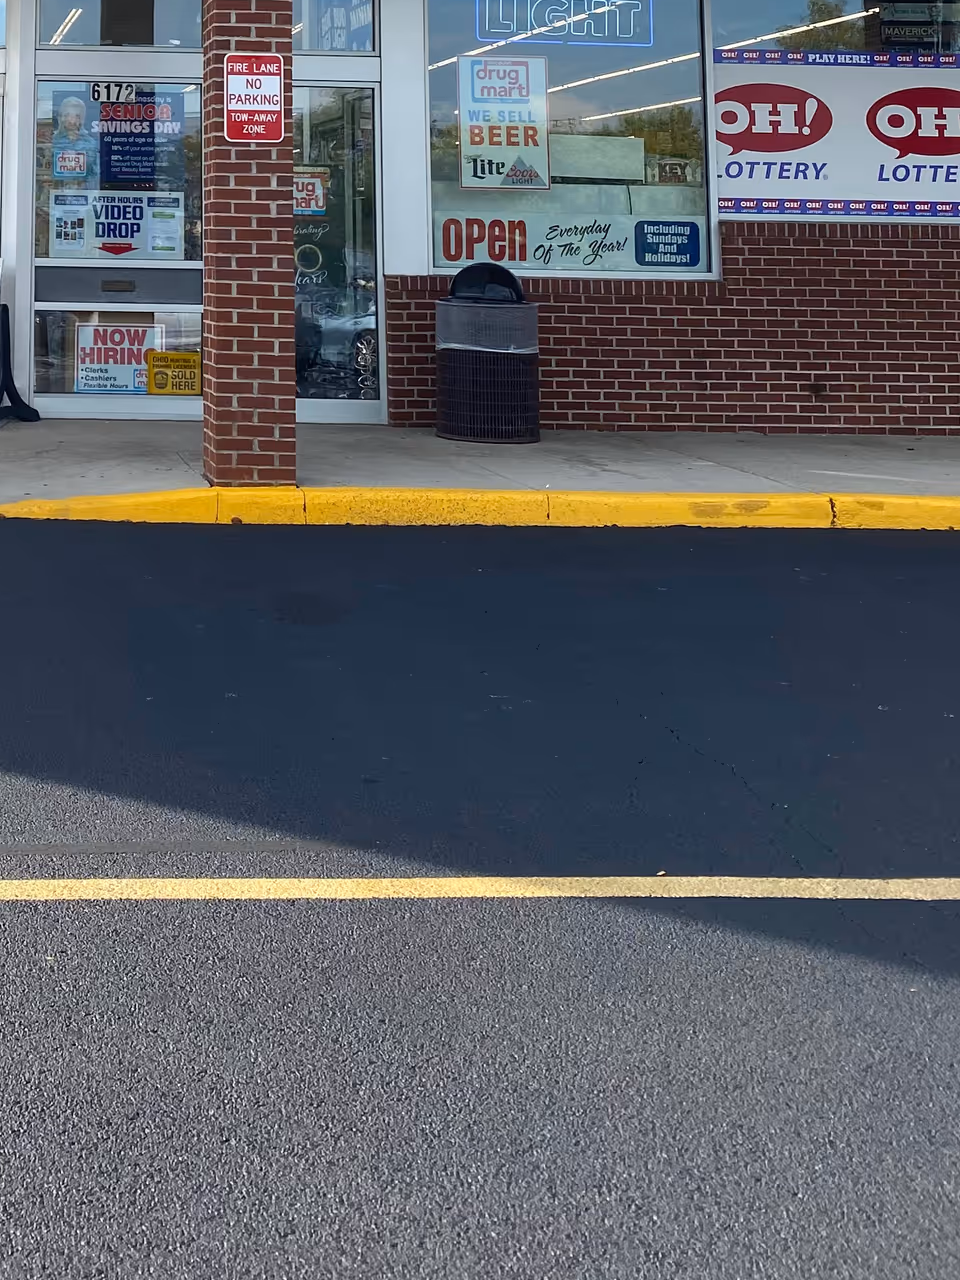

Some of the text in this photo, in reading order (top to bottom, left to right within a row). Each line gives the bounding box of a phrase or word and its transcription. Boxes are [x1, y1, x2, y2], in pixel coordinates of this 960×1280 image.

[885, 28, 935, 36] MAVERICK
[808, 54, 835, 62] PLAY
[838, 55, 870, 63] HERE!
[228, 63, 280, 73] FIRE LANE
[476, 60, 519, 85] drug
[246, 78, 262, 89] NO
[91, 83, 134, 101] 6172
[481, 84, 526, 97] mart
[229, 94, 279, 105] PARKING
[100, 103, 172, 120] SENIOR
[230, 113, 277, 122] TOW-AWAY
[468, 110, 536, 123] WE SELL
[715, 98, 818, 135] OH!
[91, 121, 181, 134] SAVINGS DAY
[243, 125, 266, 133] ZONE
[469, 125, 539, 146] BEER
[58, 152, 80, 164] drug
[60, 163, 85, 172] mart
[470, 158, 505, 179] Lite
[506, 165, 540, 177] Coors
[717, 161, 828, 180] OTTERY
[878, 164, 959, 182] LOTTE
[293, 182, 315, 196] ug
[92, 196, 116, 204] AFTER
[118, 196, 144, 204] HOURS
[92, 205, 144, 220] VIDEO
[95, 222, 141, 238] DROP
[546, 220, 612, 240] Everyday
[644, 224, 690, 235] Including
[647, 234, 688, 244] Sundays
[533, 237, 628, 266] Of The Year!
[658, 243, 677, 252] And
[644, 252, 690, 263] Holidays!
[93, 328, 147, 346] NOW
[171, 370, 196, 380] SOLD
[172, 381, 196, 390] HERE
